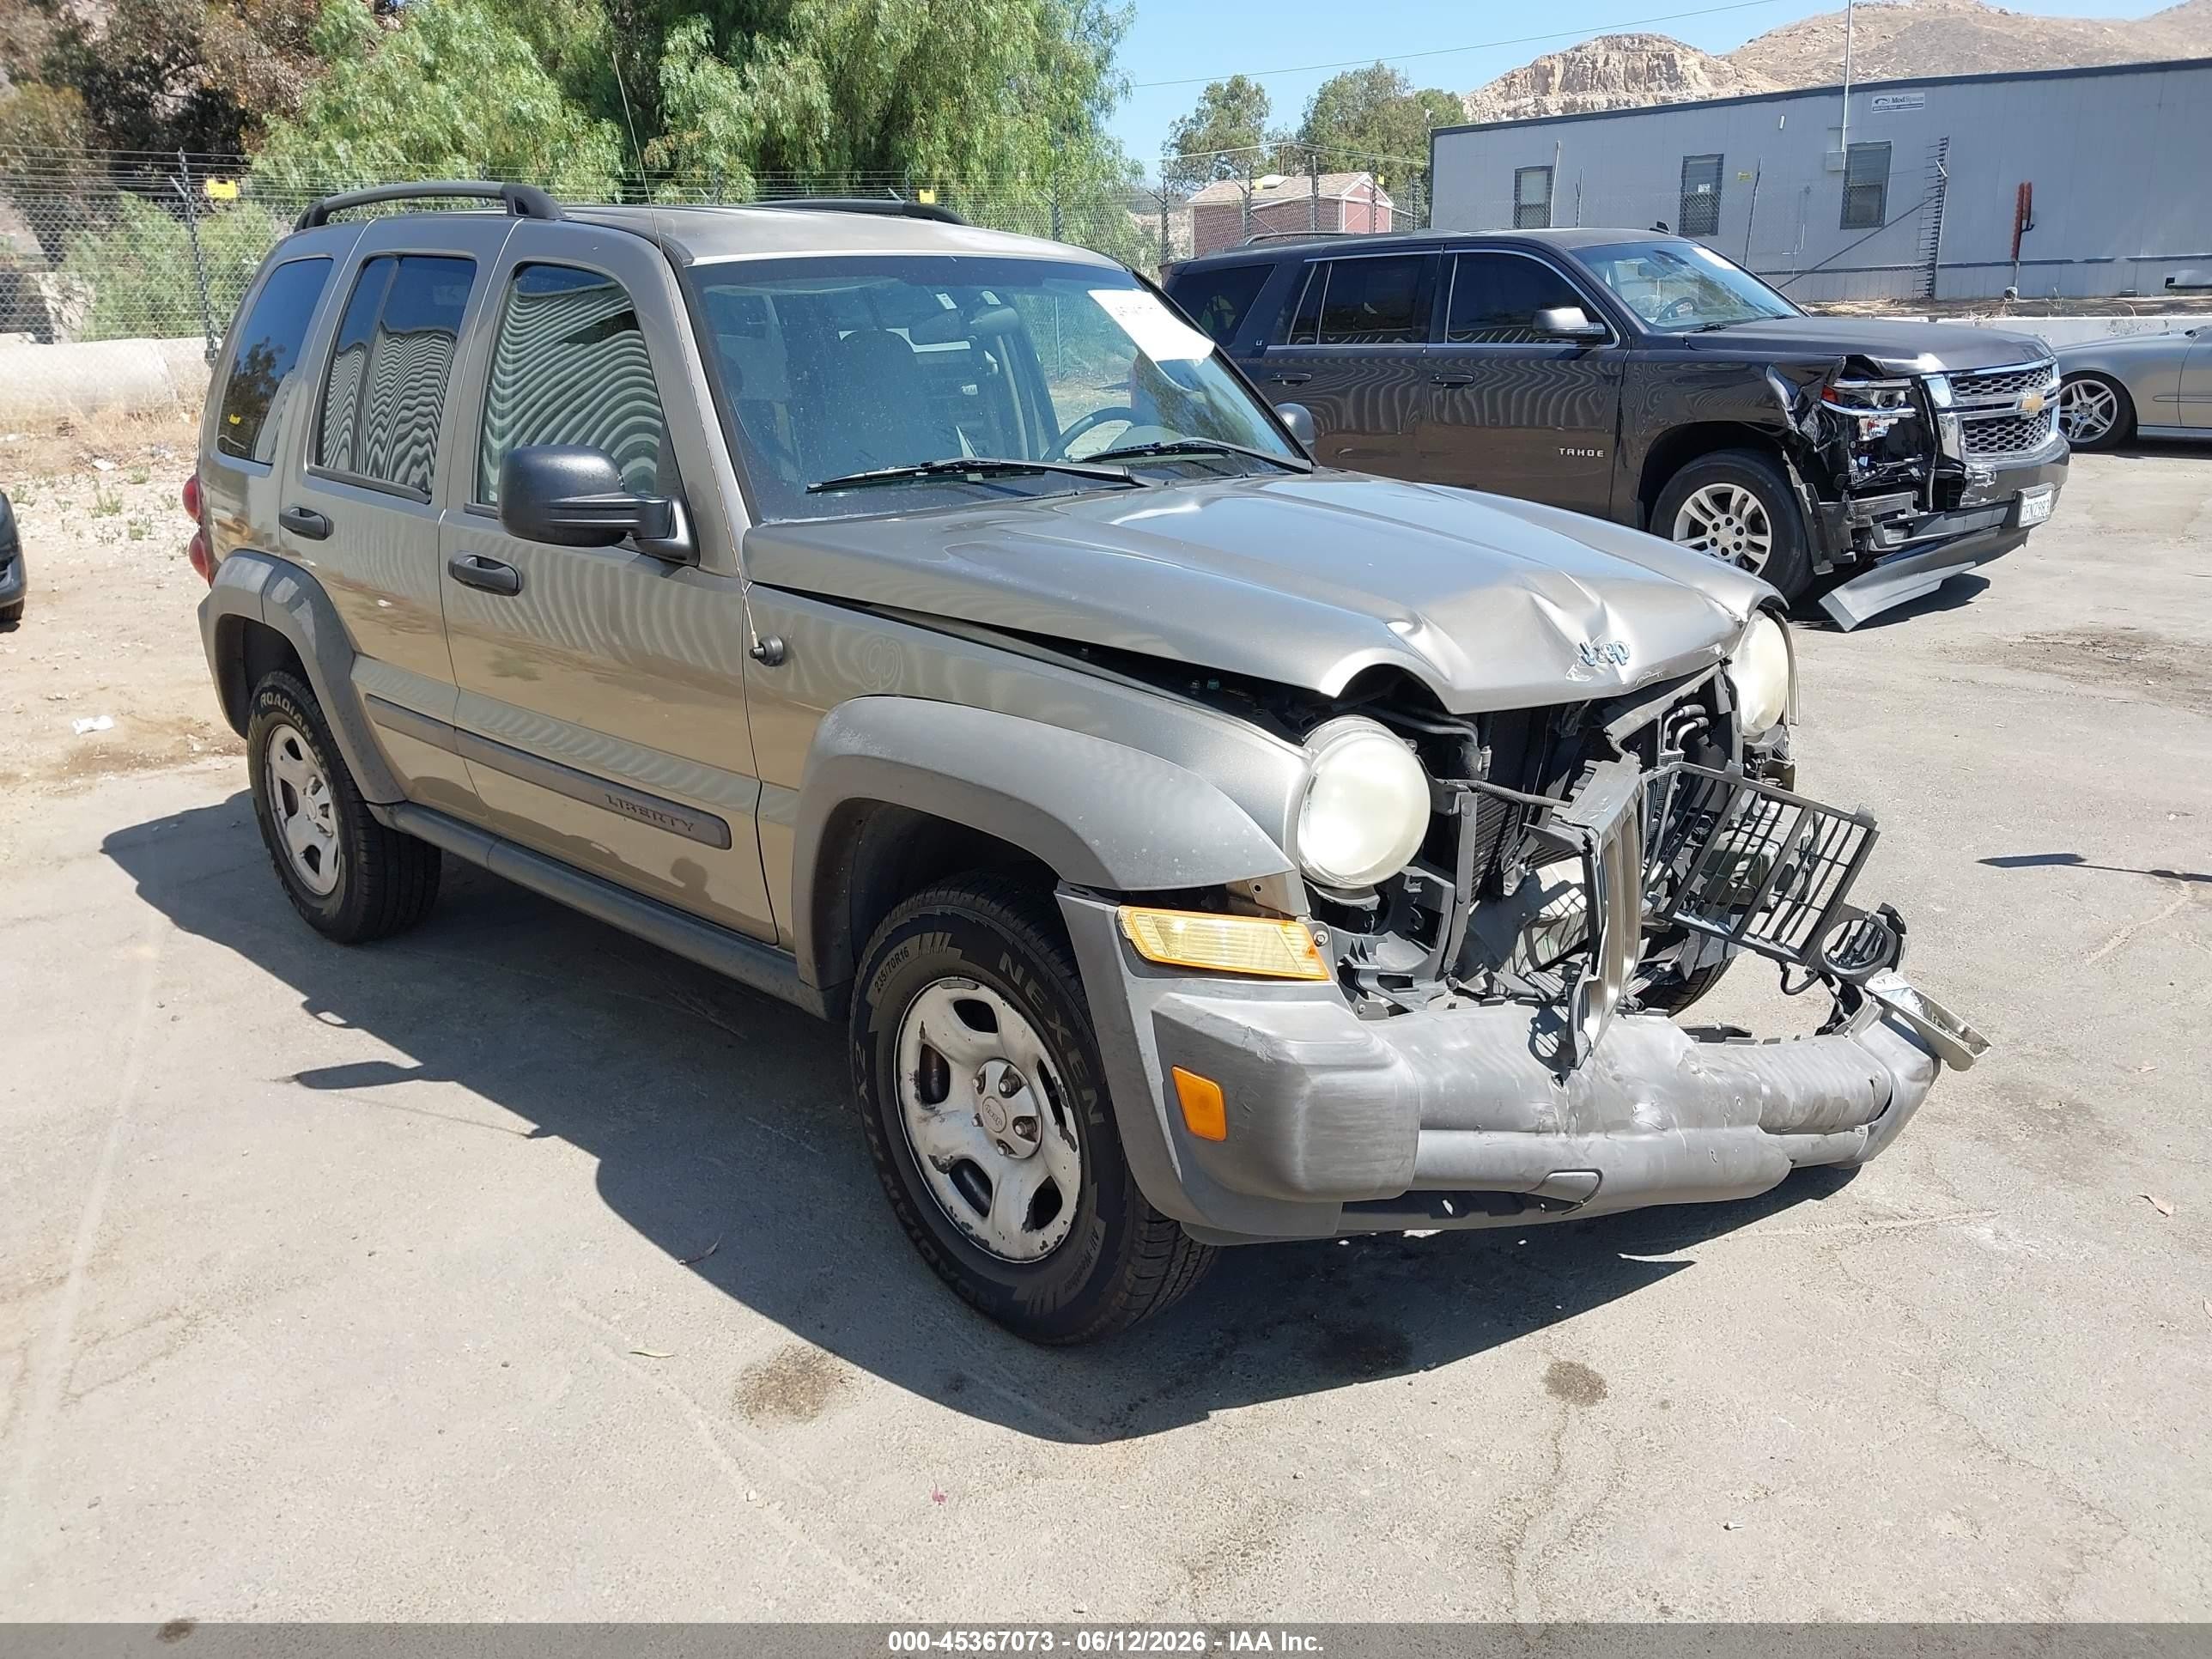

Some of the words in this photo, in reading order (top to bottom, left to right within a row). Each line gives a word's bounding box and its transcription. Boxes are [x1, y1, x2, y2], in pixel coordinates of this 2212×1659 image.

[1559, 447, 1604, 458] TAHOE
[260, 691, 313, 740] ROADIAN
[605, 793, 694, 831] LIBERTY
[874, 946, 909, 994] 235/70R16
[999, 951, 1105, 1125] NEXEN
